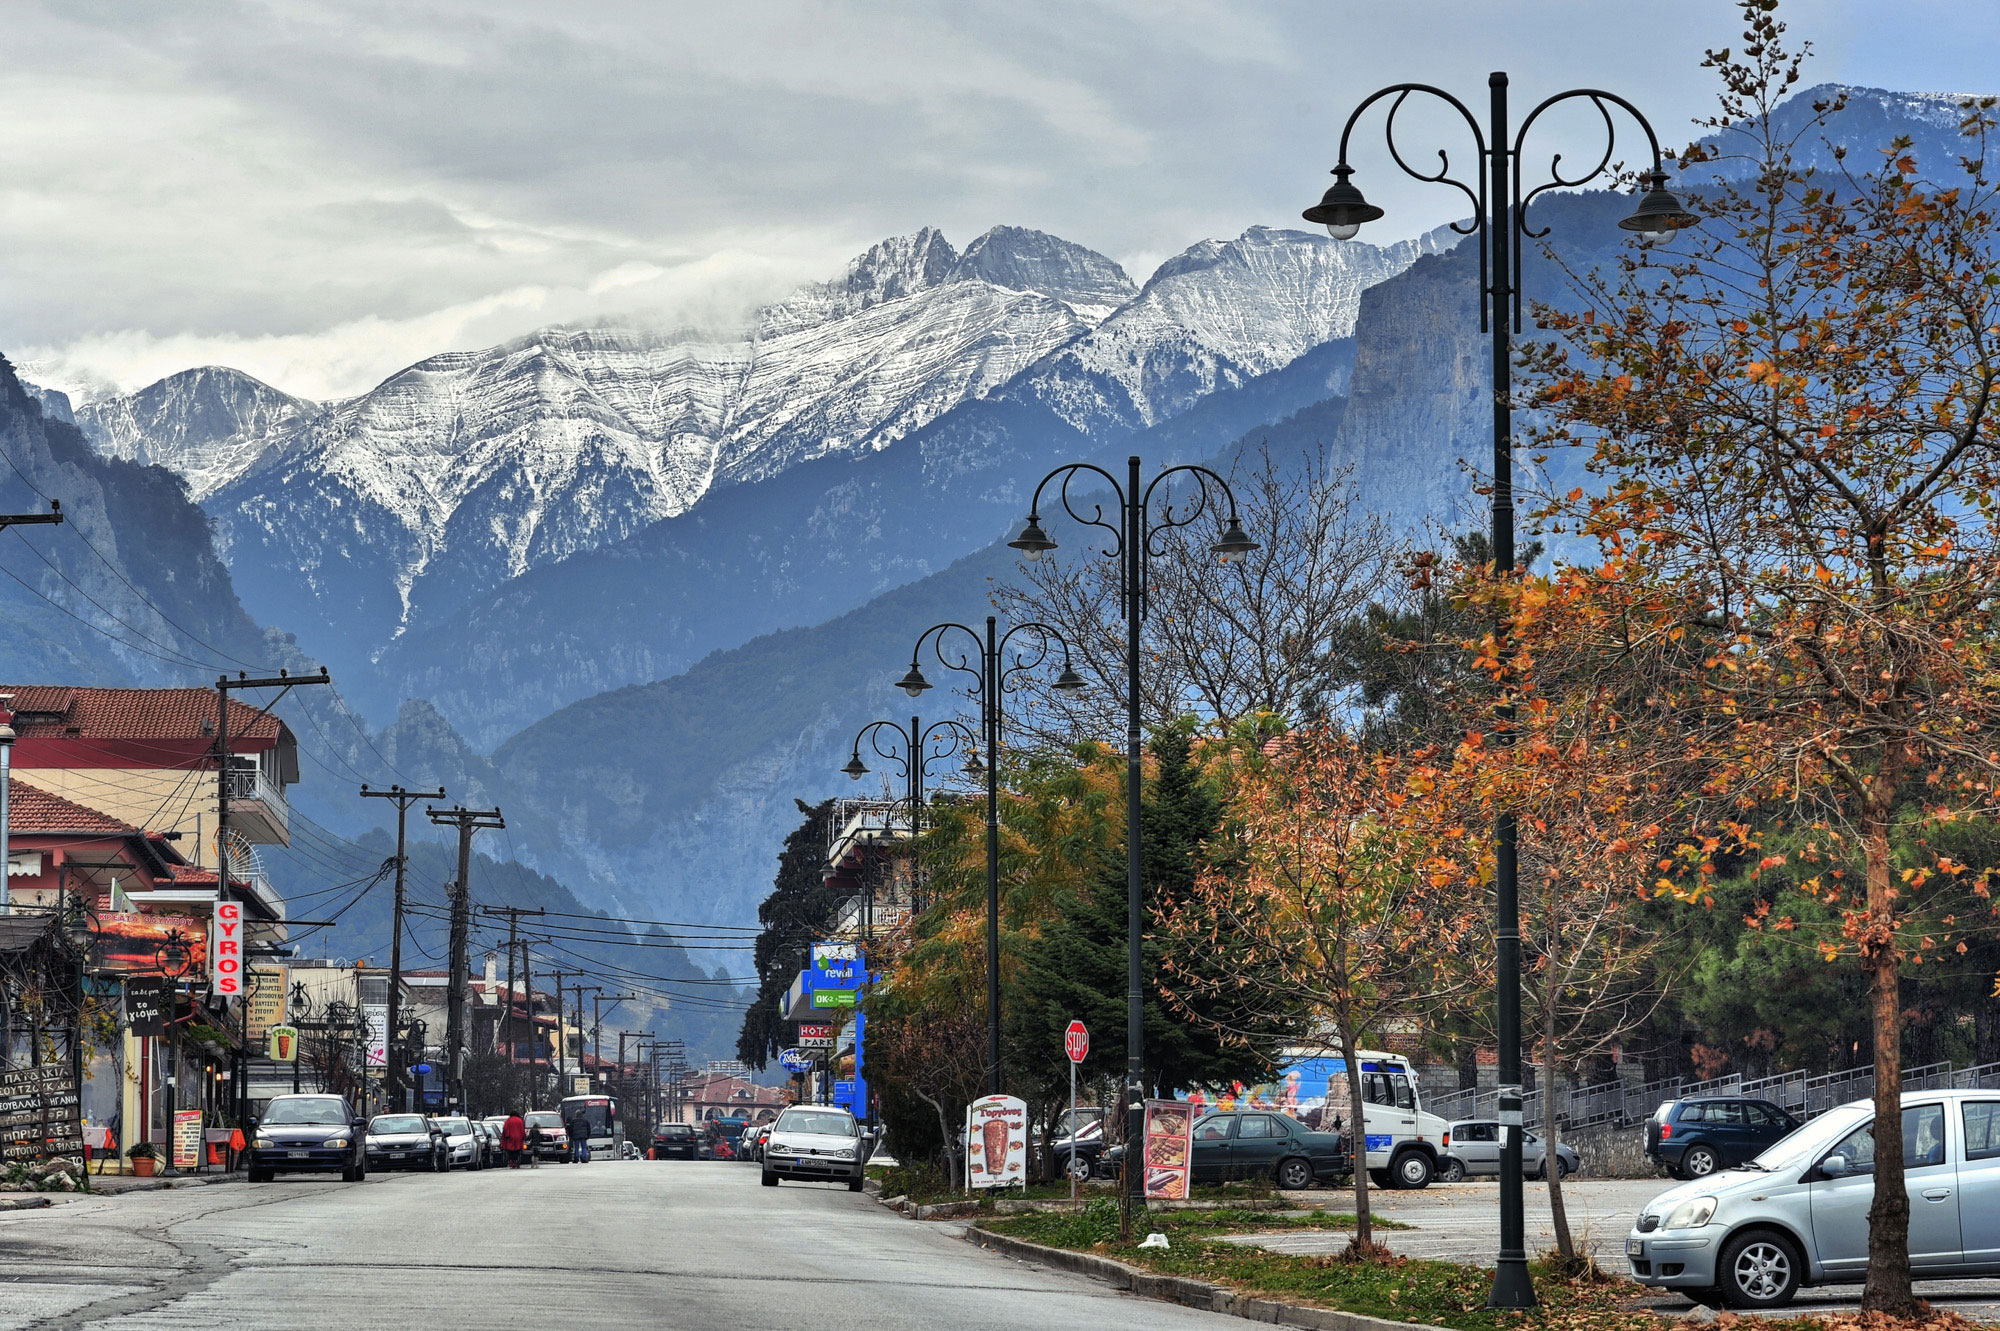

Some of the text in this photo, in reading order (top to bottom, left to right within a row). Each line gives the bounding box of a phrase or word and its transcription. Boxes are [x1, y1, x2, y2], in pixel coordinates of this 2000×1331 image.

[218, 904, 239, 993] GYROS
[804, 1038, 833, 1046] PARK
[1067, 1031, 1087, 1052] STOP
